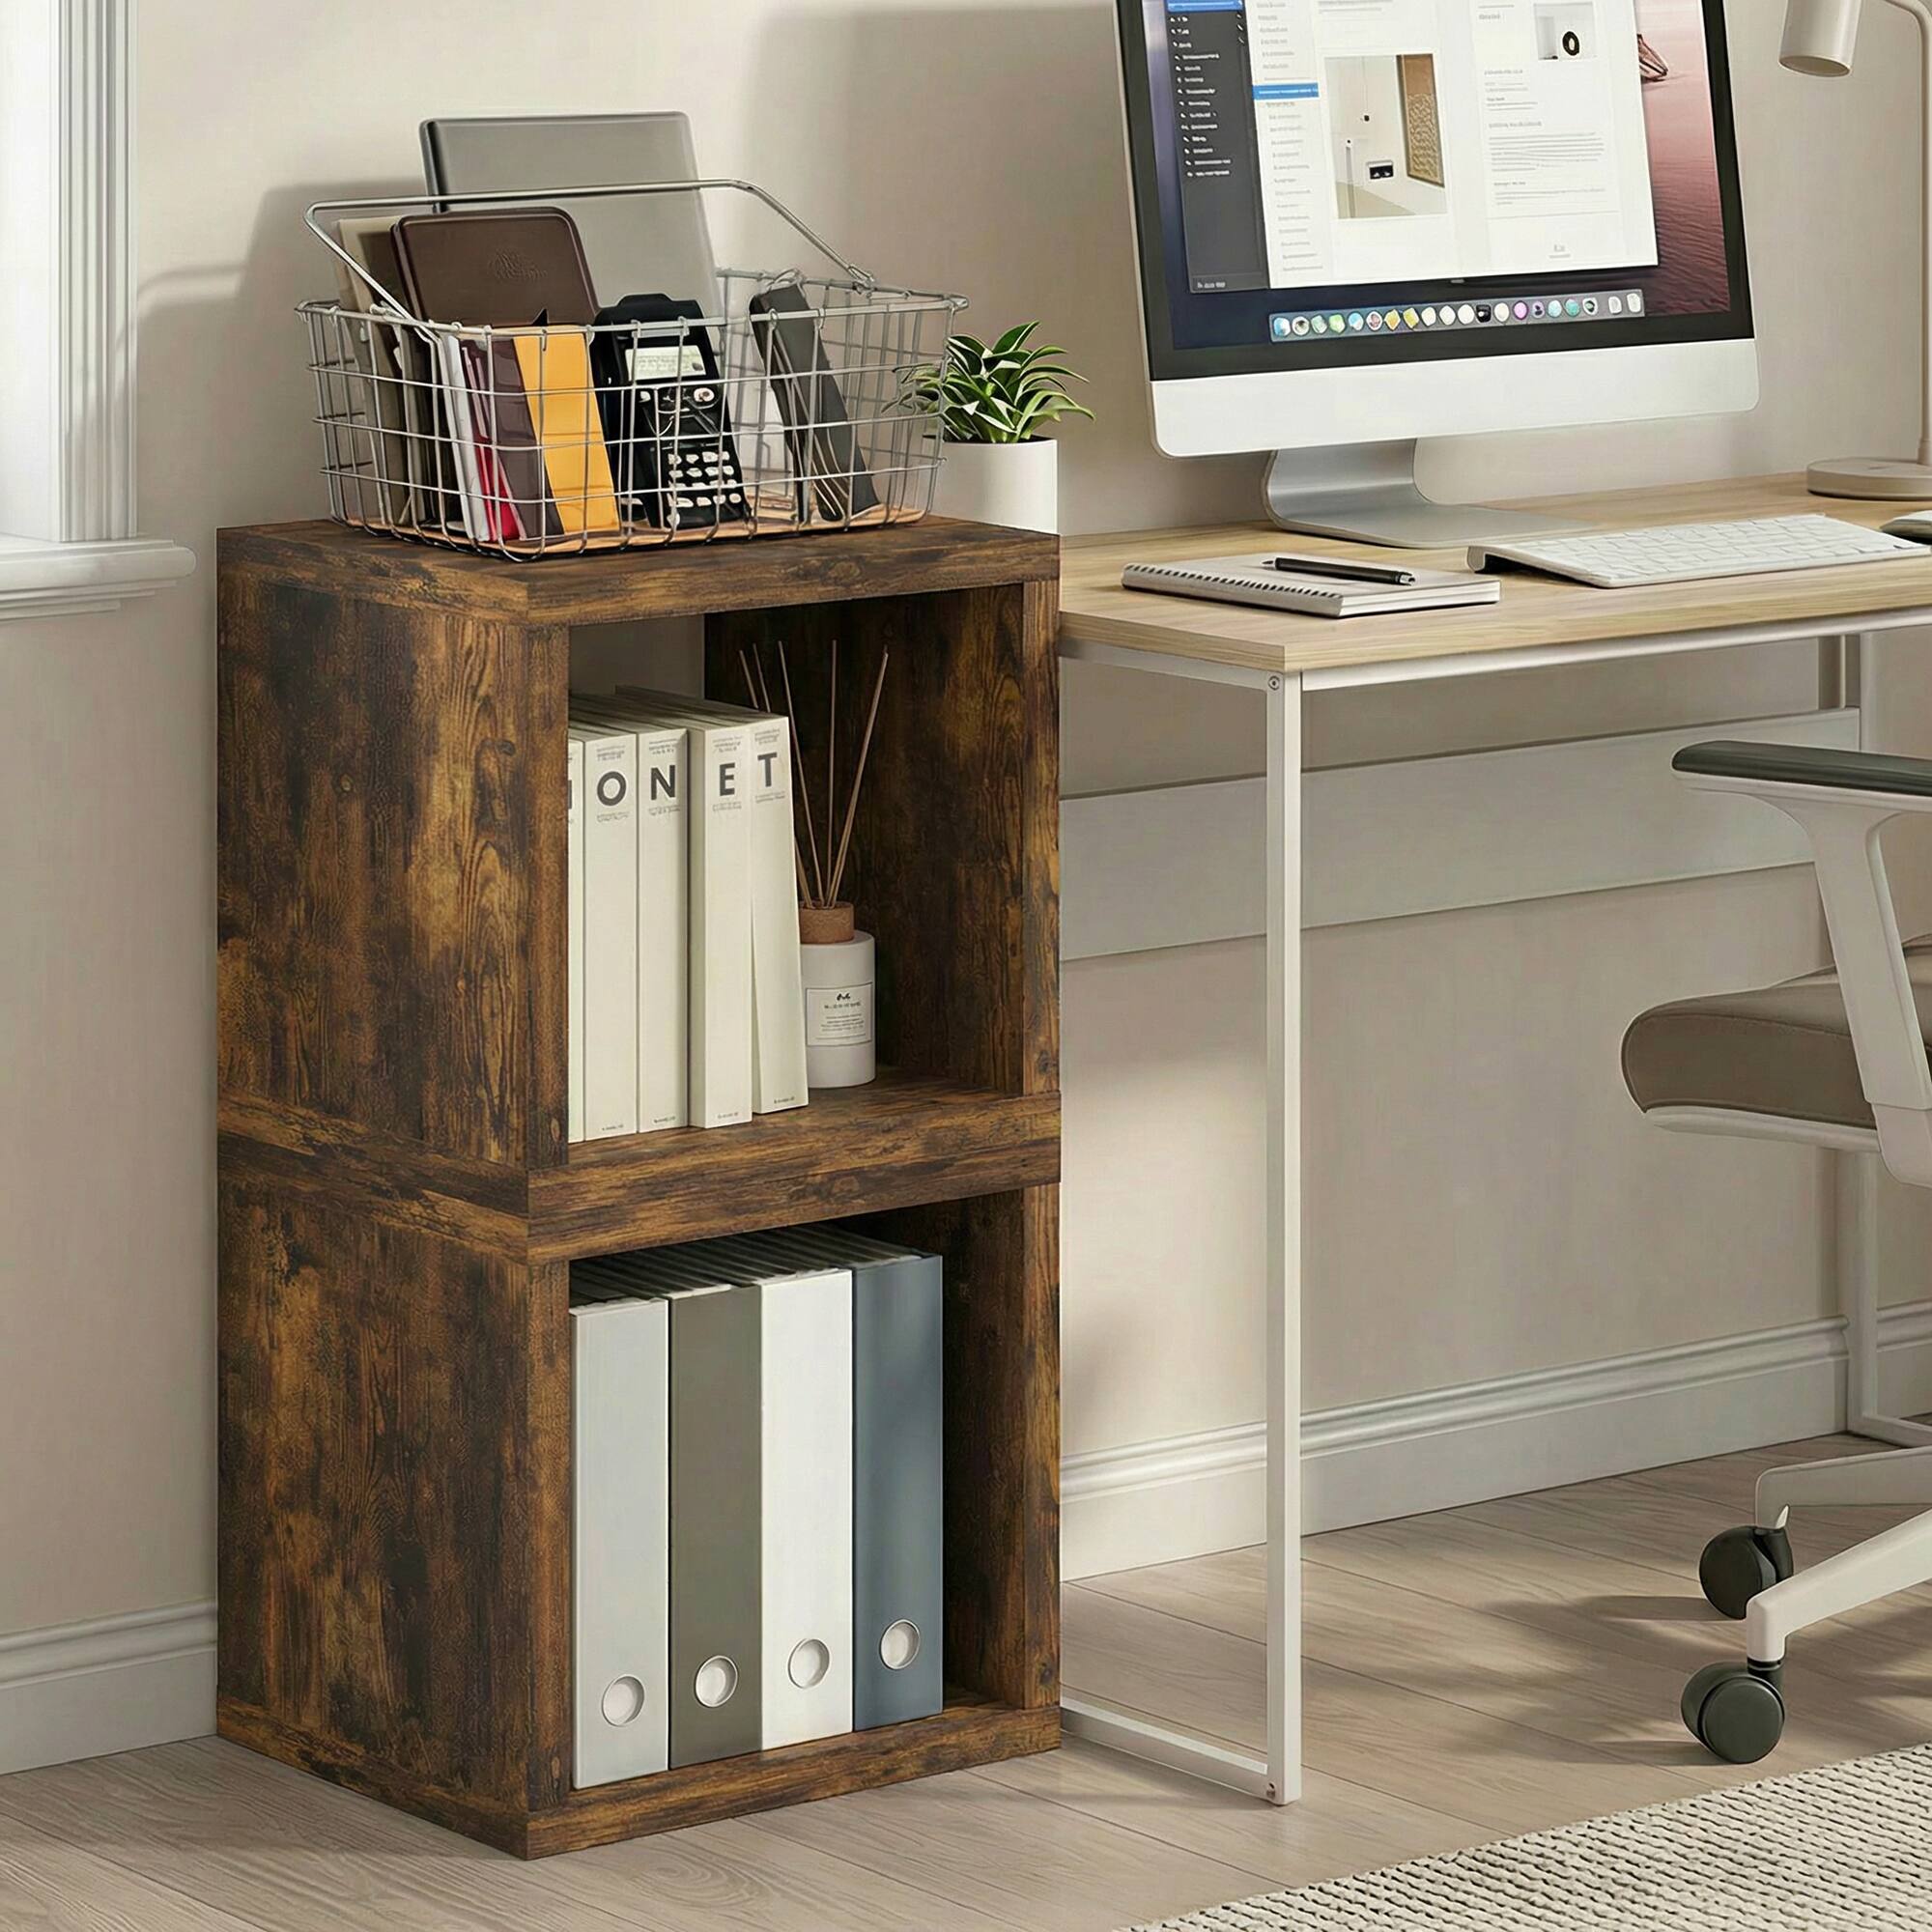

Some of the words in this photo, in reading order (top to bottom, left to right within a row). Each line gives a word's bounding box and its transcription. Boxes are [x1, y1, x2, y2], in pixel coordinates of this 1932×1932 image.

[650, 764, 676, 800] N
[719, 762, 736, 796] E
[757, 752, 778, 787] T
[597, 771, 627, 806] O
